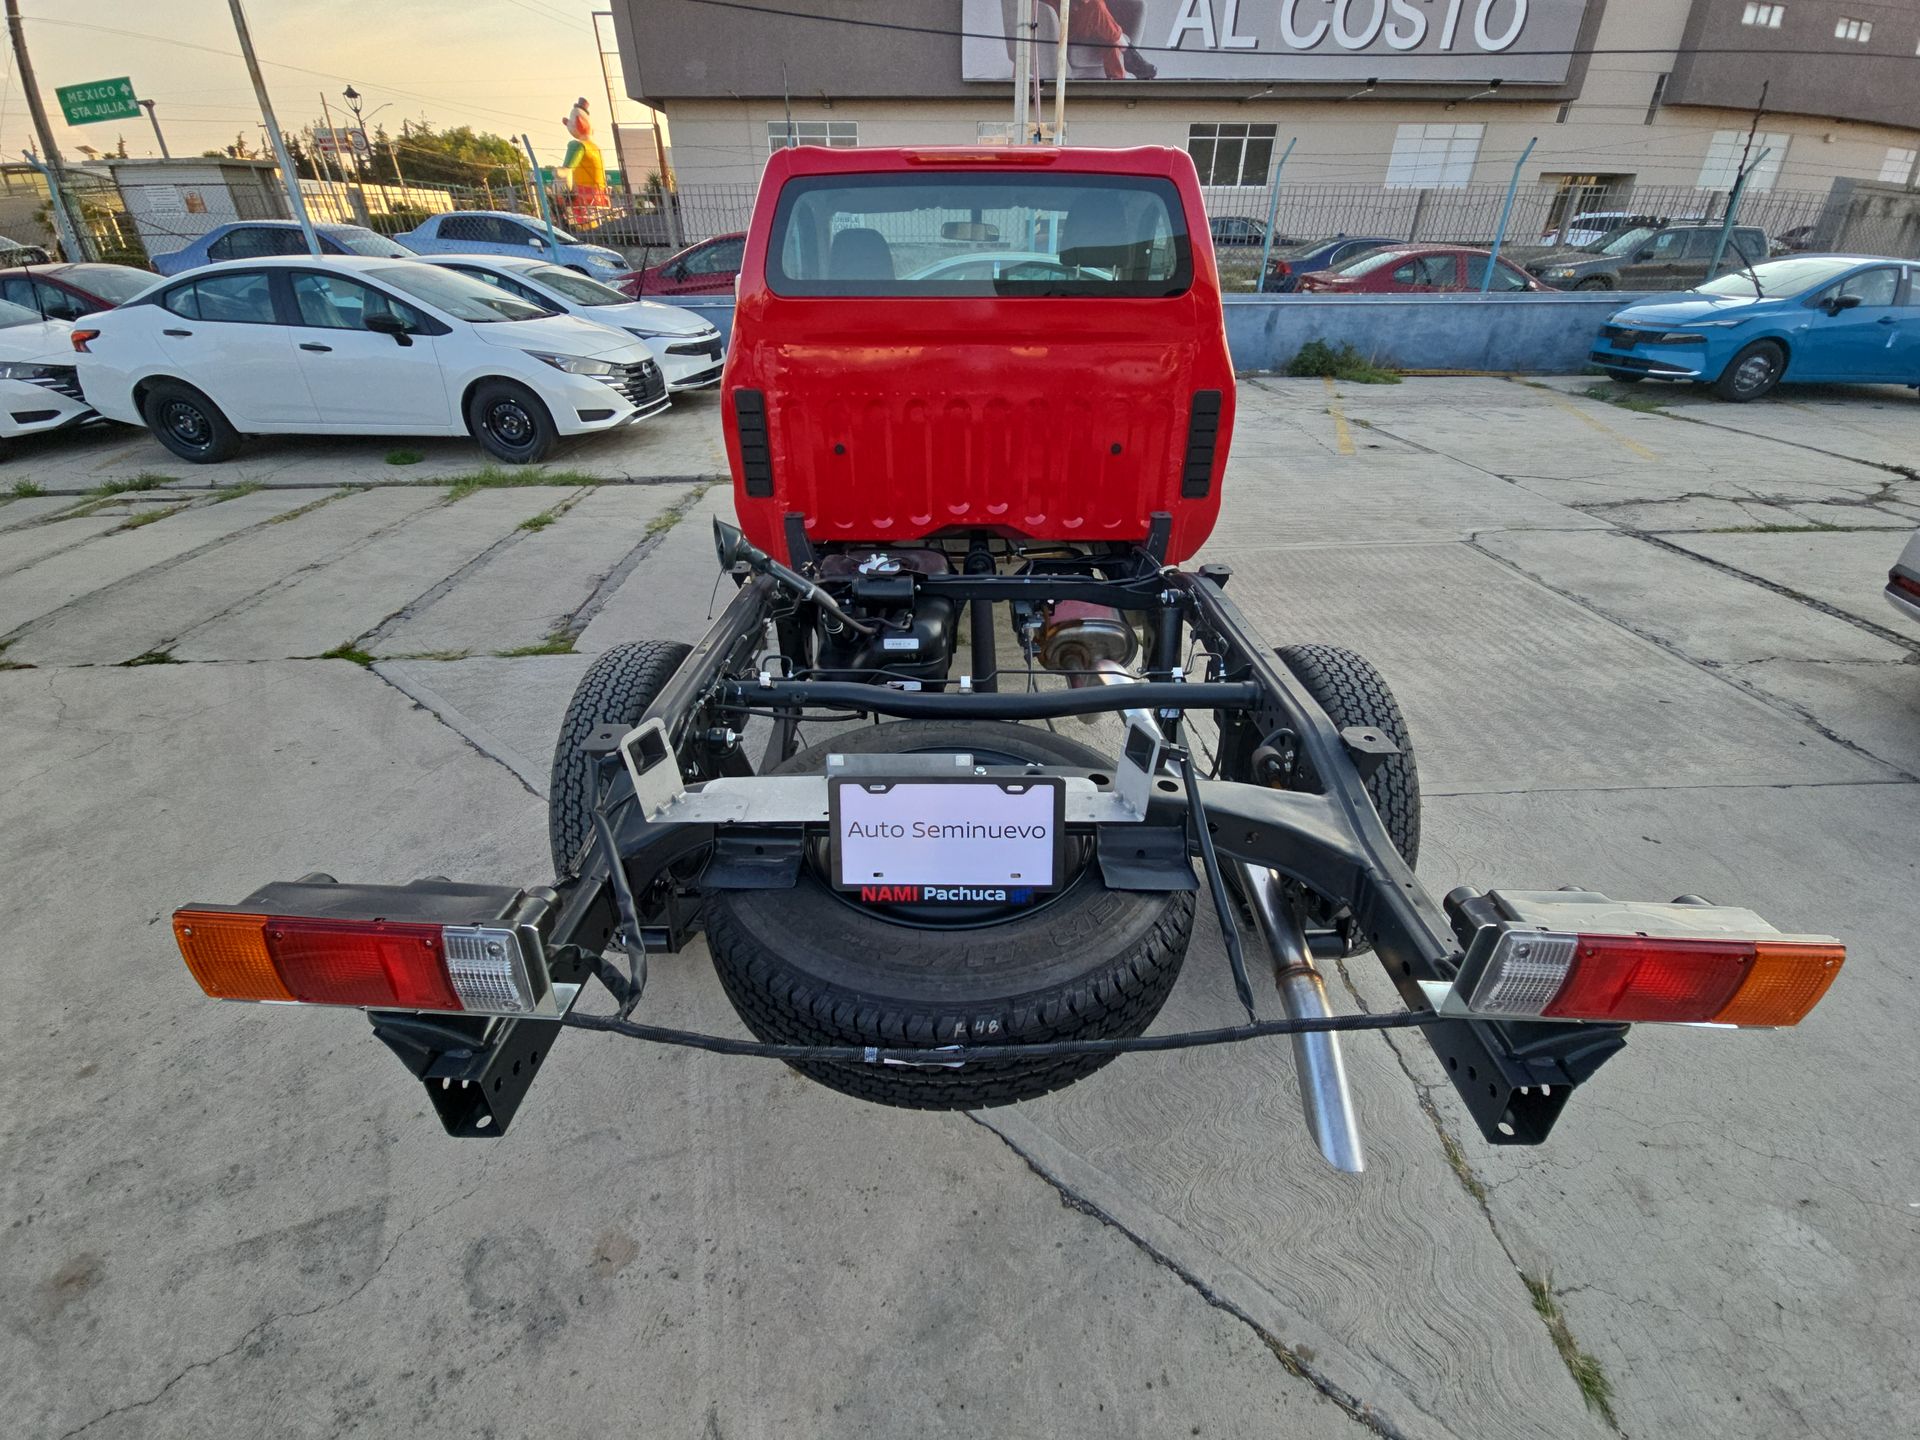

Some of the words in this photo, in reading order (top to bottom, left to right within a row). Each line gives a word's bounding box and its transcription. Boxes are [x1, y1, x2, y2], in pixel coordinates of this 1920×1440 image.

[1166, 0, 1257, 49] AL
[66, 86, 116, 103] MEXICO
[70, 106, 92, 119] STA
[94, 101, 127, 116] JULIA
[848, 821, 905, 838] Auto
[912, 821, 1046, 839] Seminuevo
[861, 886, 918, 902] NAMI
[924, 886, 1006, 902] Pachuca
